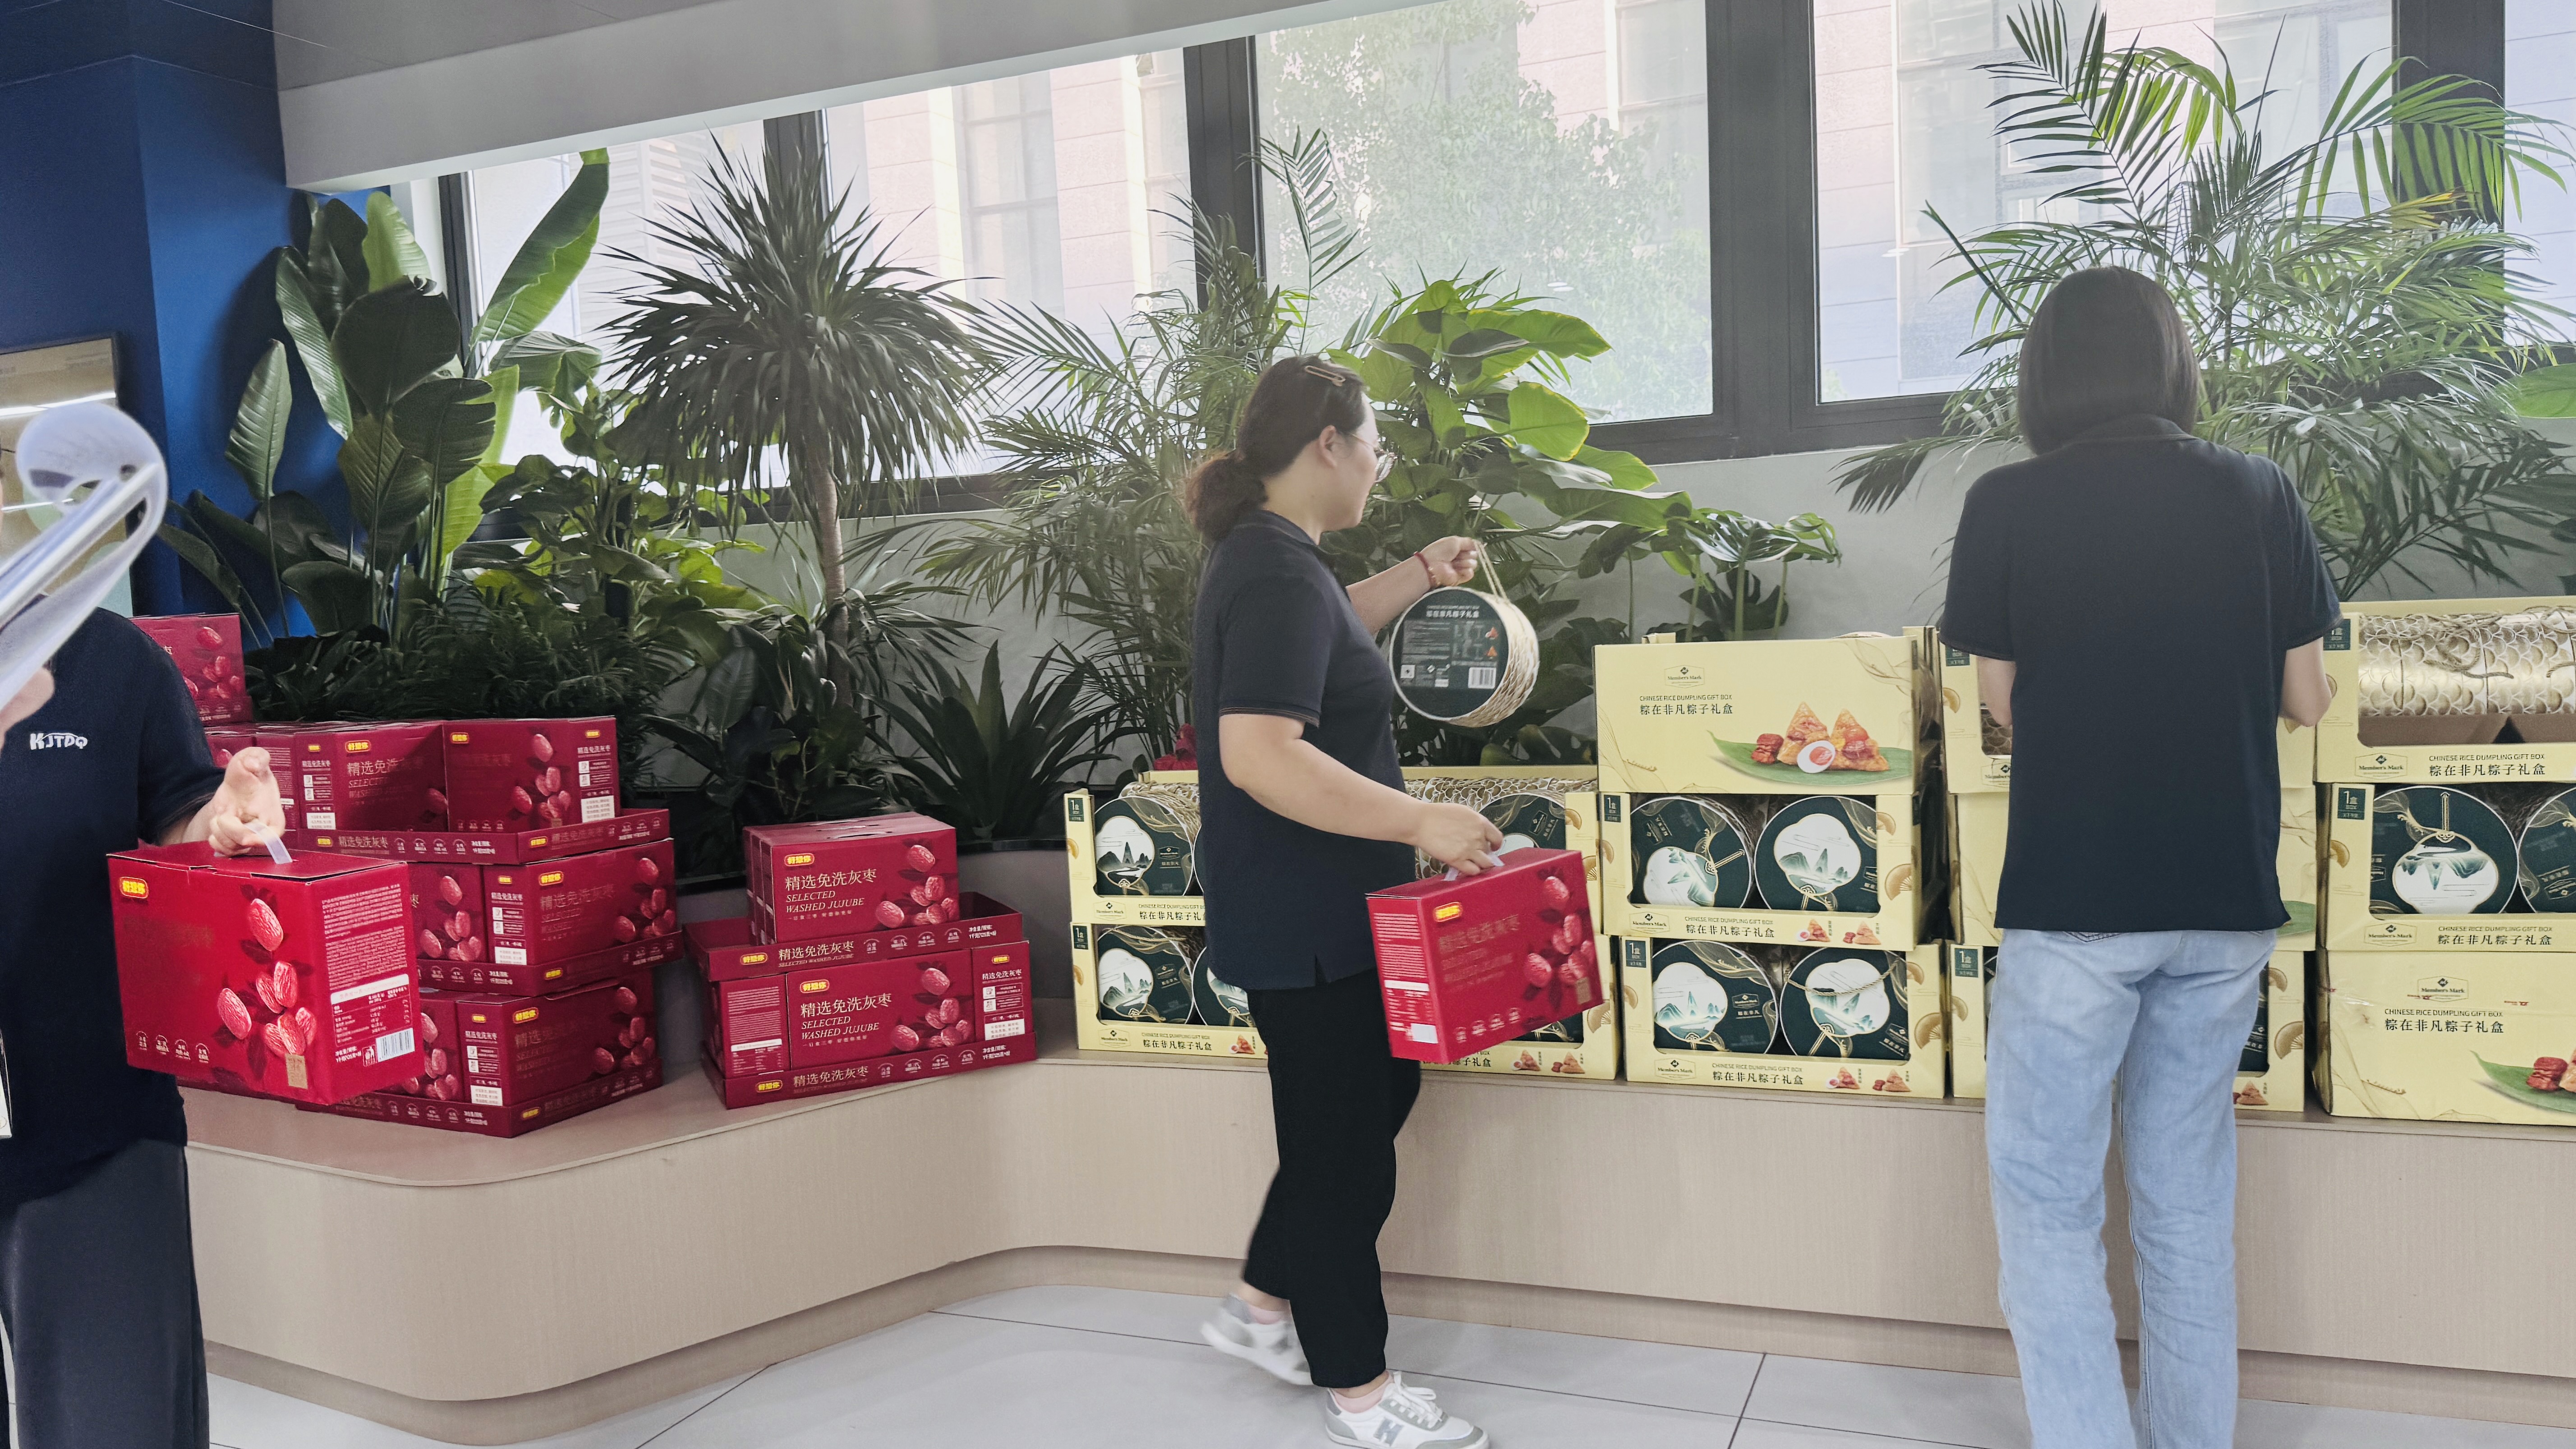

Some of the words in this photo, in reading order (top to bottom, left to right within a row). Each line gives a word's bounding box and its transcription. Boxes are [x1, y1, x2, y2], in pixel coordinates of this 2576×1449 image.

[1640, 703, 1733, 715] 粽在非凡粽子礼盒
[2429, 763, 2546, 777] 粽在非凡粽子礼盒
[785, 869, 877, 891] 精选免洗灰枣
[787, 891, 836, 902] SELECTED
[787, 902, 826, 913] WASHED
[828, 898, 865, 909] JUJUBE
[1140, 911, 1205, 920] 粽在非凡粽子礼
[1686, 925, 1775, 938] 粽在非凡粽子礼盒
[2438, 935, 2552, 946] 粽在非凡粽子礼盒
[778, 941, 854, 961] 精选免洗灰枣
[800, 993, 892, 1018] 精选免洗灰枣
[801, 1017, 851, 1030] SELECTED
[2385, 1019, 2504, 1033] 粽在非凡粽子礼盒
[802, 1028, 841, 1040] WASHED
[843, 1022, 879, 1035] JUJUBE
[793, 1066, 869, 1088] 精选免洗灰枣
[1713, 1071, 1803, 1085] 粽在非凡粽子礼盒
